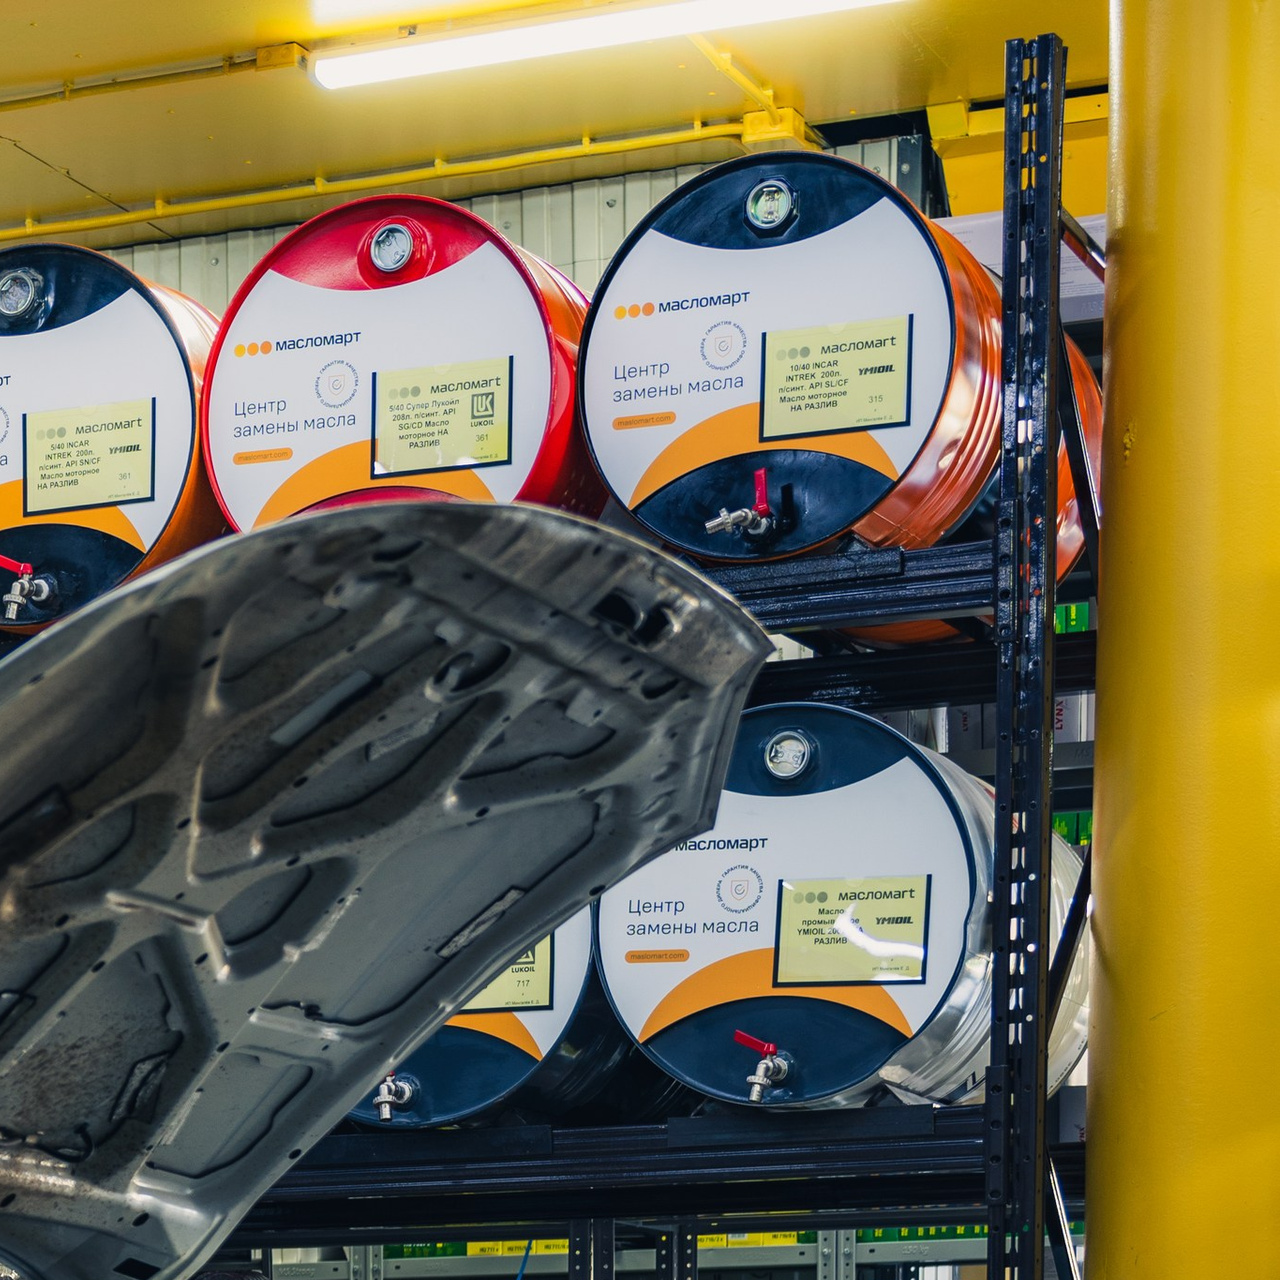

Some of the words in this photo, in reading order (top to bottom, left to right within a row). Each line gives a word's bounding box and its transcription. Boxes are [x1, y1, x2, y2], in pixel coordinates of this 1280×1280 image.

[659, 291, 750, 313] масломарт
[276, 332, 361, 351] масломарт
[790, 363, 810, 371] 10/40
[812, 360, 838, 369] INCAR
[614, 362, 670, 382] Центр
[785, 373, 816, 382] INTREK
[613, 383, 682, 403] замены
[688, 376, 744, 394] масла
[778, 384, 806, 393] п/синт.
[809, 381, 822, 390] API
[779, 394, 805, 403] Масло
[808, 390, 847, 400] моторное
[868, 395, 883, 403] 315
[234, 399, 287, 418] Центр
[389, 404, 404, 412] 5/40
[407, 402, 429, 412] Супер
[432, 398, 460, 408] Лукойл
[790, 404, 802, 412] НА
[805, 400, 838, 410] РАЗЛИВ
[443, 408, 456, 416] API
[233, 421, 299, 438] замены
[304, 413, 356, 431] масла
[425, 420, 450, 428] Масло
[470, 420, 494, 428] LUKOIL
[399, 431, 436, 441] моторное
[437, 429, 449, 437] НА
[50, 443, 64, 451] 5/40
[67, 440, 89, 449] INCAR
[409, 439, 440, 449] РАЗЛИВ
[45, 452, 72, 461] INTREK
[65, 460, 77, 468] API
[40, 472, 63, 480] Масло
[65, 468, 100, 478] моторное
[50, 479, 79, 489] РАЗЛИВ
[675, 838, 768, 852] масломарт
[628, 899, 685, 916] Центр
[626, 922, 697, 936] замены
[702, 920, 759, 934] масла
[814, 937, 848, 945] РАЗЛИВ
[630, 952, 685, 960] maslomart.com
